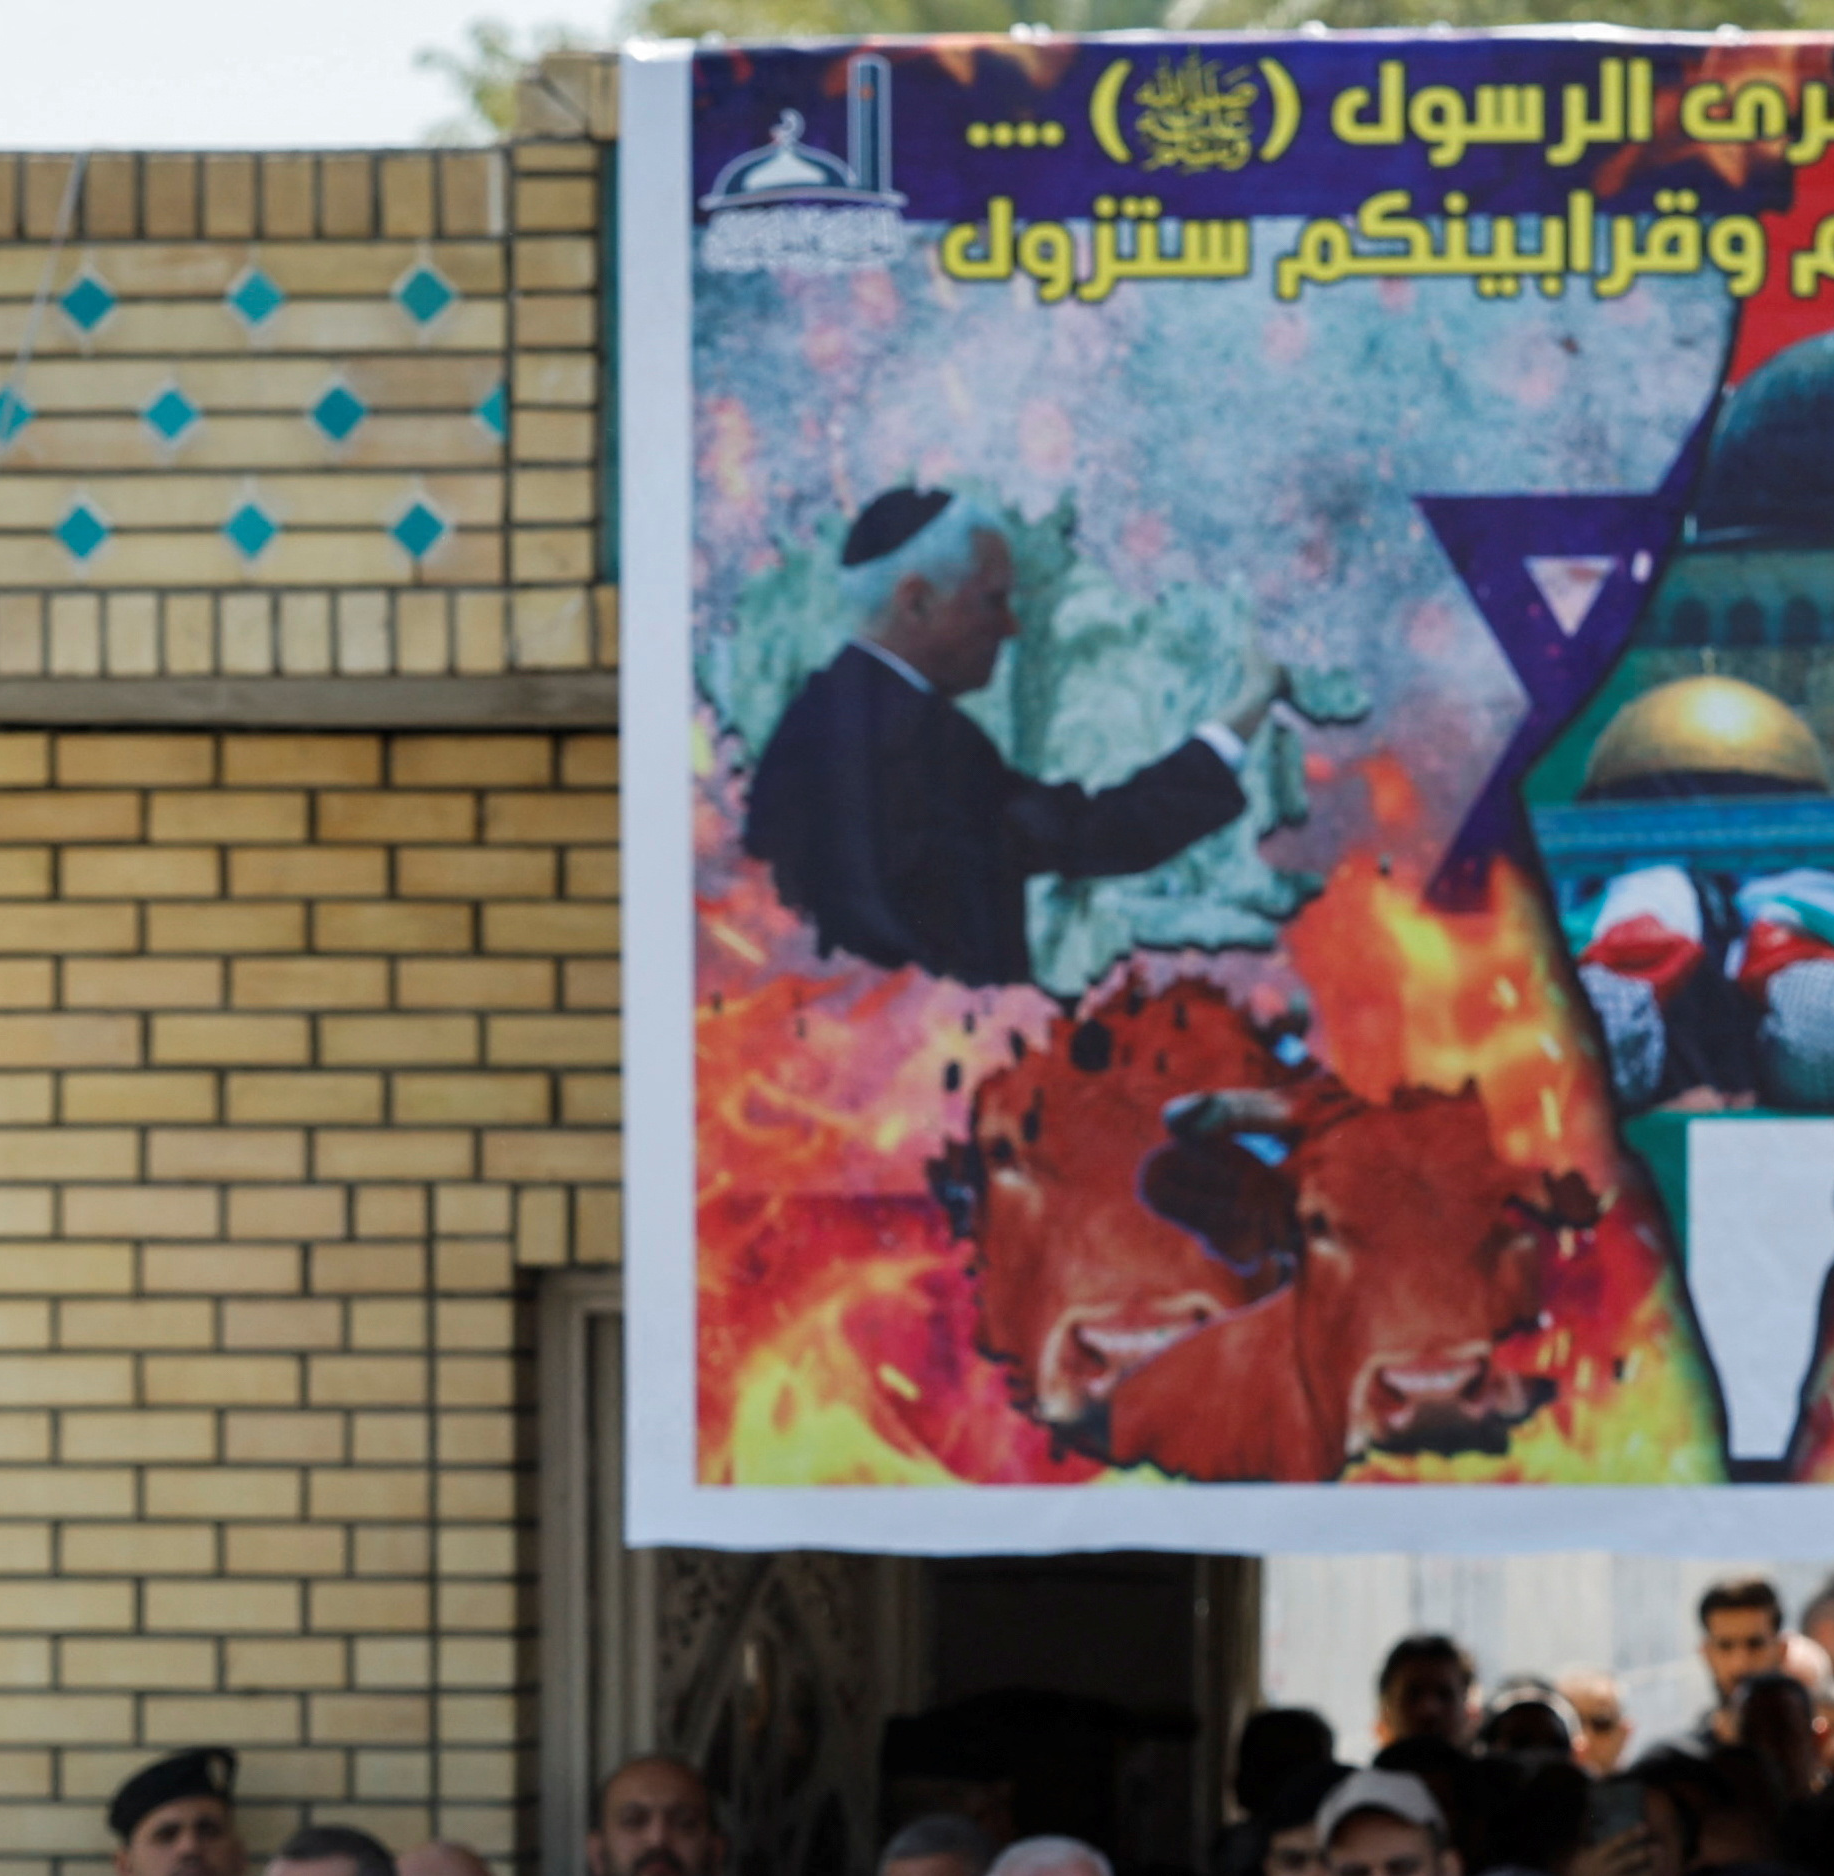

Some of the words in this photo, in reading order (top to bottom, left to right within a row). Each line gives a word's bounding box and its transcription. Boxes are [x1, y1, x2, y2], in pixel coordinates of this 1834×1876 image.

[1331, 58, 1655, 166] الرسول
[940, 194, 1249, 301] ستزول
[1275, 189, 1766, 300] وقرابينكم
